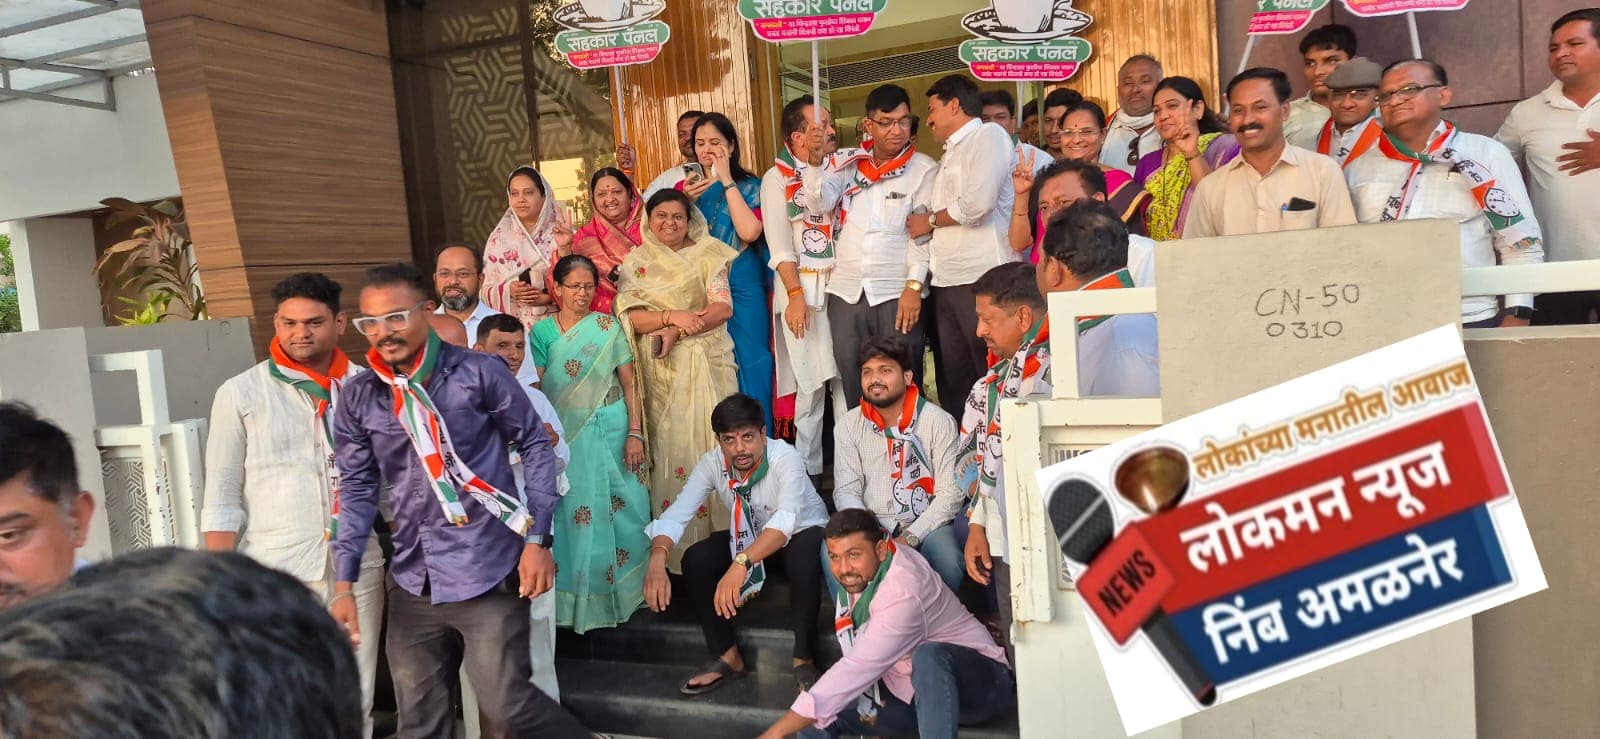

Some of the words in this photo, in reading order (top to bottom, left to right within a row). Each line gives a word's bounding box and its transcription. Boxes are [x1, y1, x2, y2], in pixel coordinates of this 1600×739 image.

[566, 33, 619, 52] सहकार
[971, 45, 1034, 62] सहकार
[1255, 284, 1360, 316] CN-50
[1266, 321, 1343, 339] 0310
